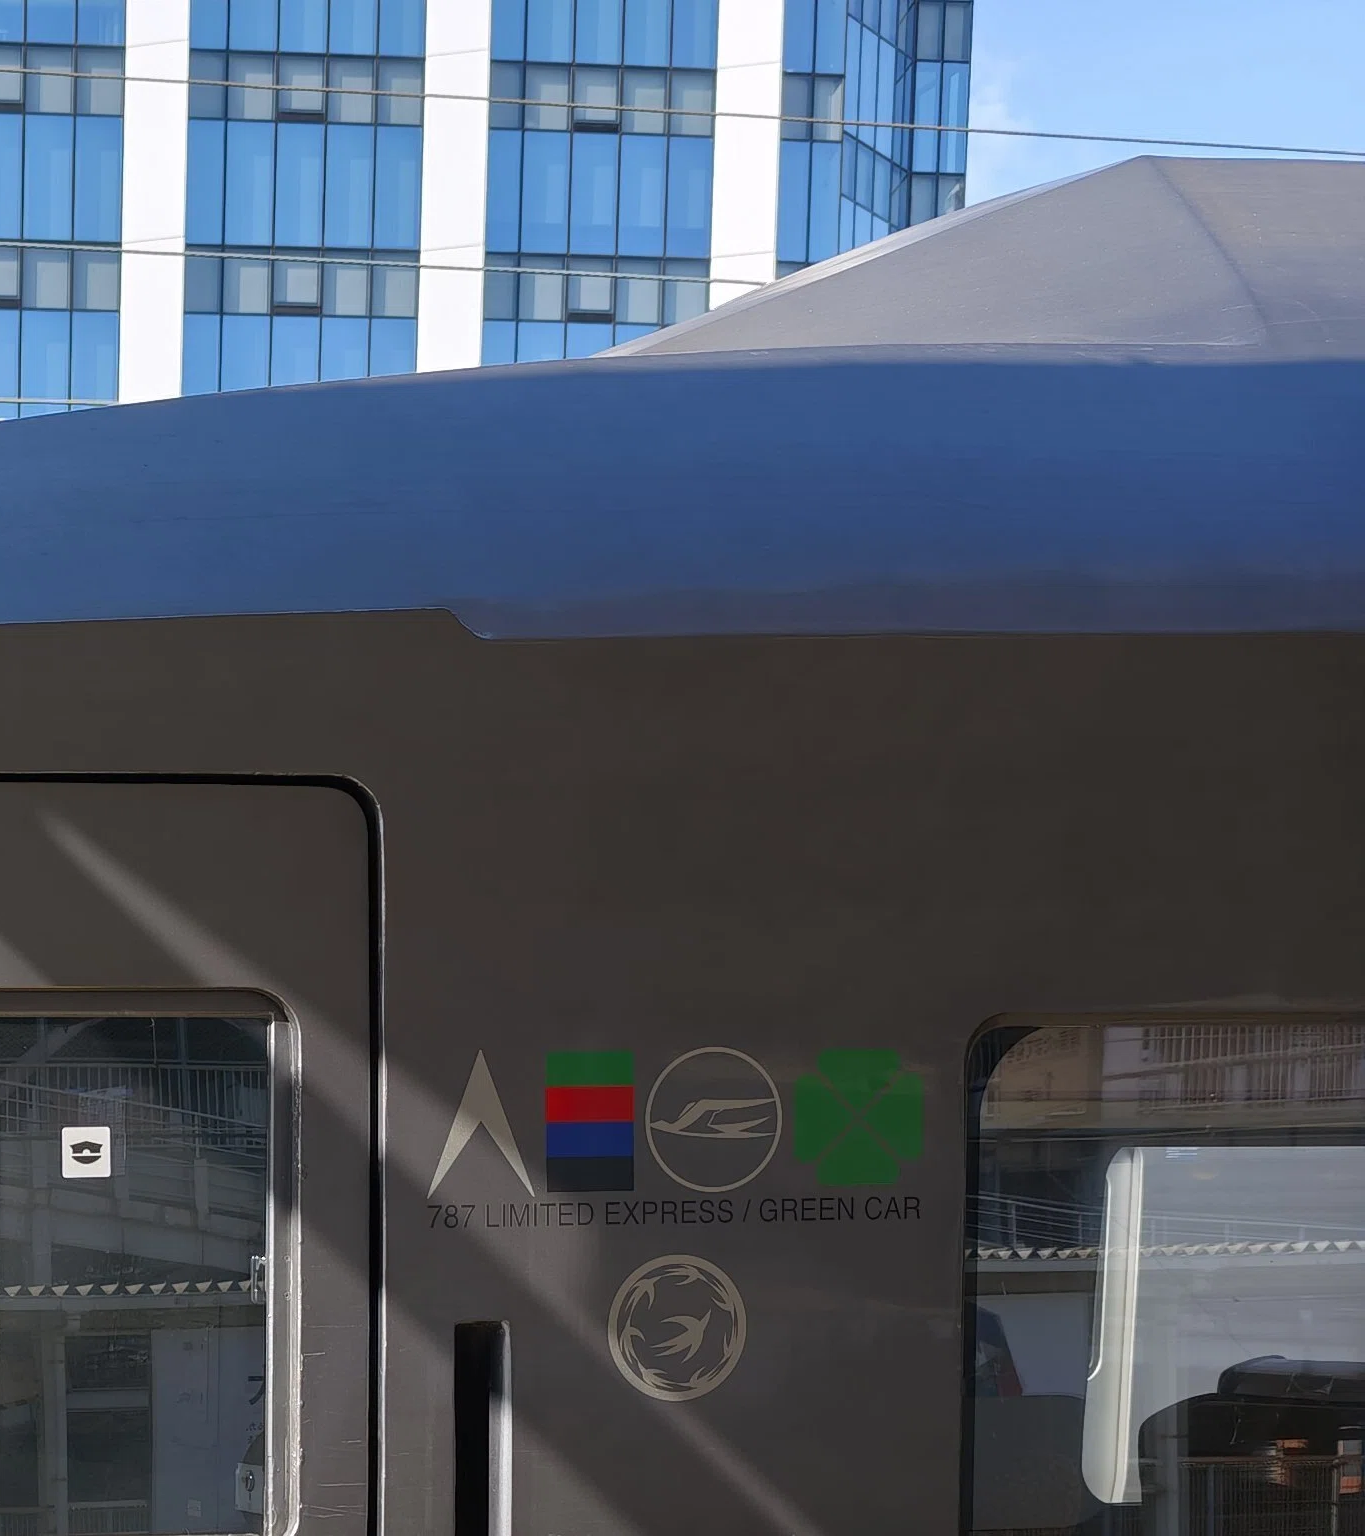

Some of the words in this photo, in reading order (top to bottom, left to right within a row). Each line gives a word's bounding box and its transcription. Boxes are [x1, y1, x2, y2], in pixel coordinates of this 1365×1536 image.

[427, 1204, 476, 1229] 787
[486, 1202, 594, 1228] LIMITED
[605, 1199, 734, 1225] EXPRESS
[759, 1197, 854, 1222] GREEN
[864, 1196, 921, 1220] CAR
